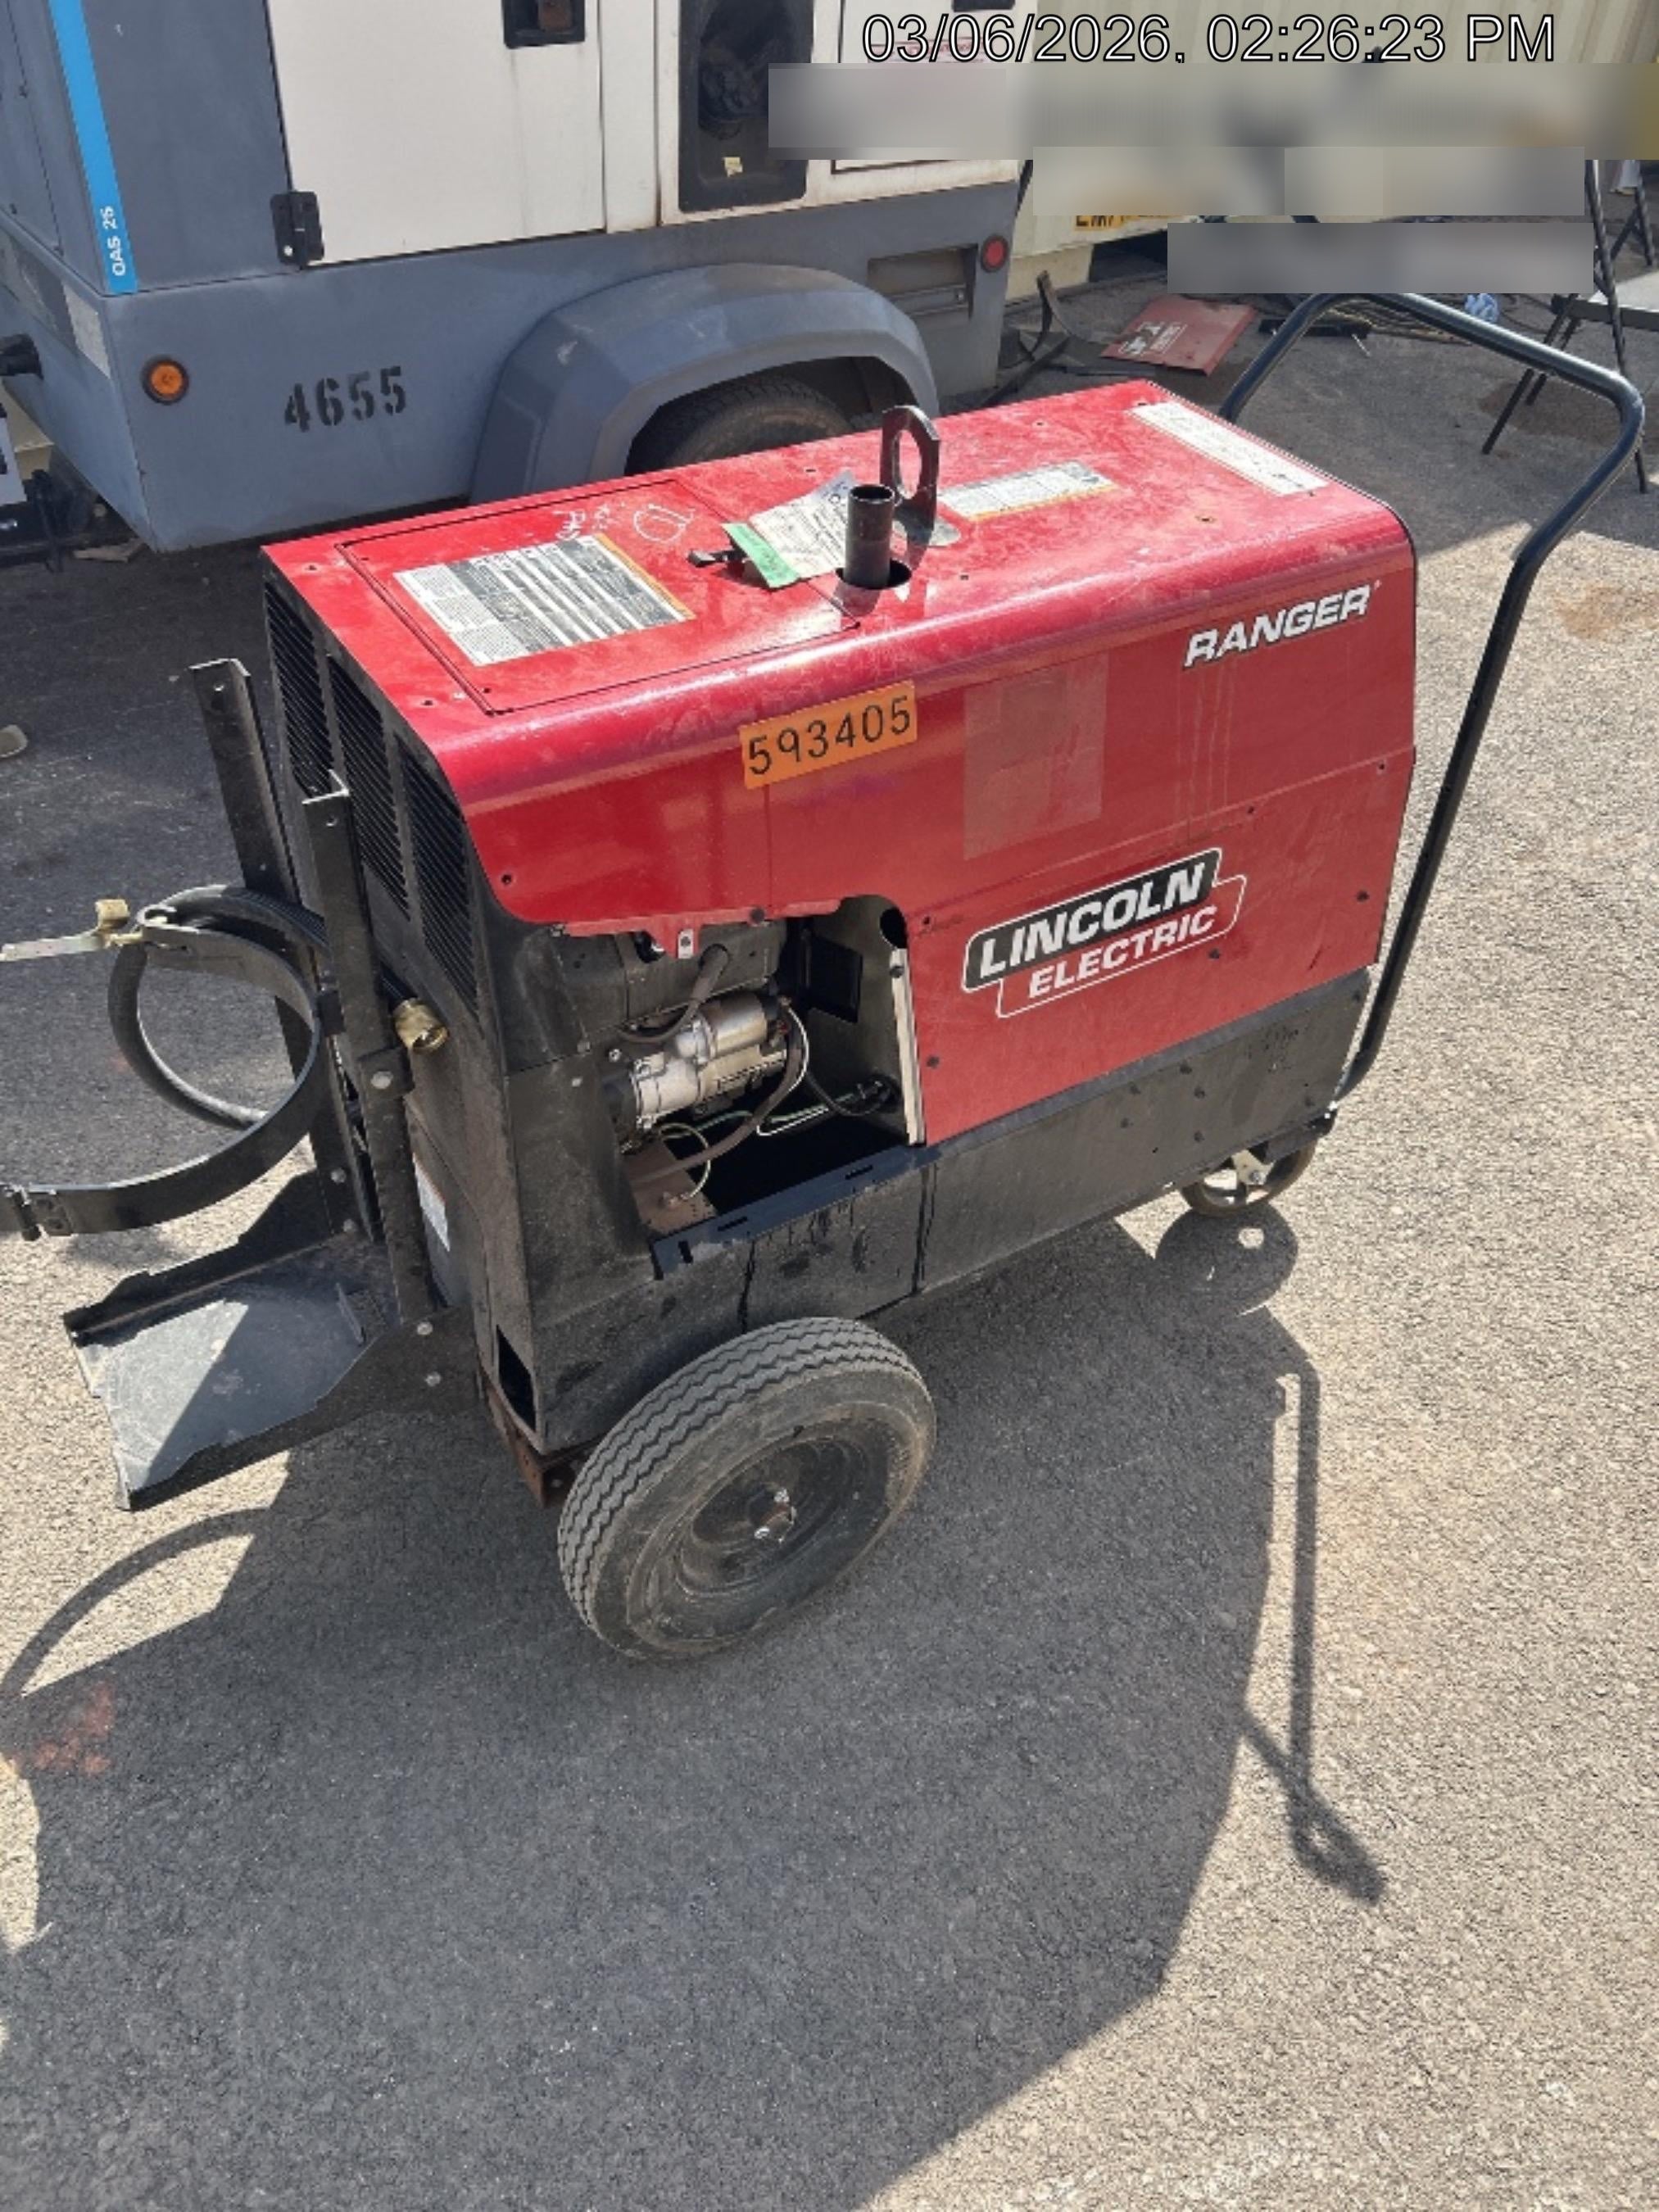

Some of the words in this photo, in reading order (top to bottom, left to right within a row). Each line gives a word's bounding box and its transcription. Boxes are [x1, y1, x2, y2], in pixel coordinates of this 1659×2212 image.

[285, 366, 406, 433] 4655
[1183, 584, 1371, 668] RANGER
[749, 696, 910, 774] 593405
[980, 863, 1205, 978] LINCOLN
[1029, 905, 1217, 998] ELECTRIC
